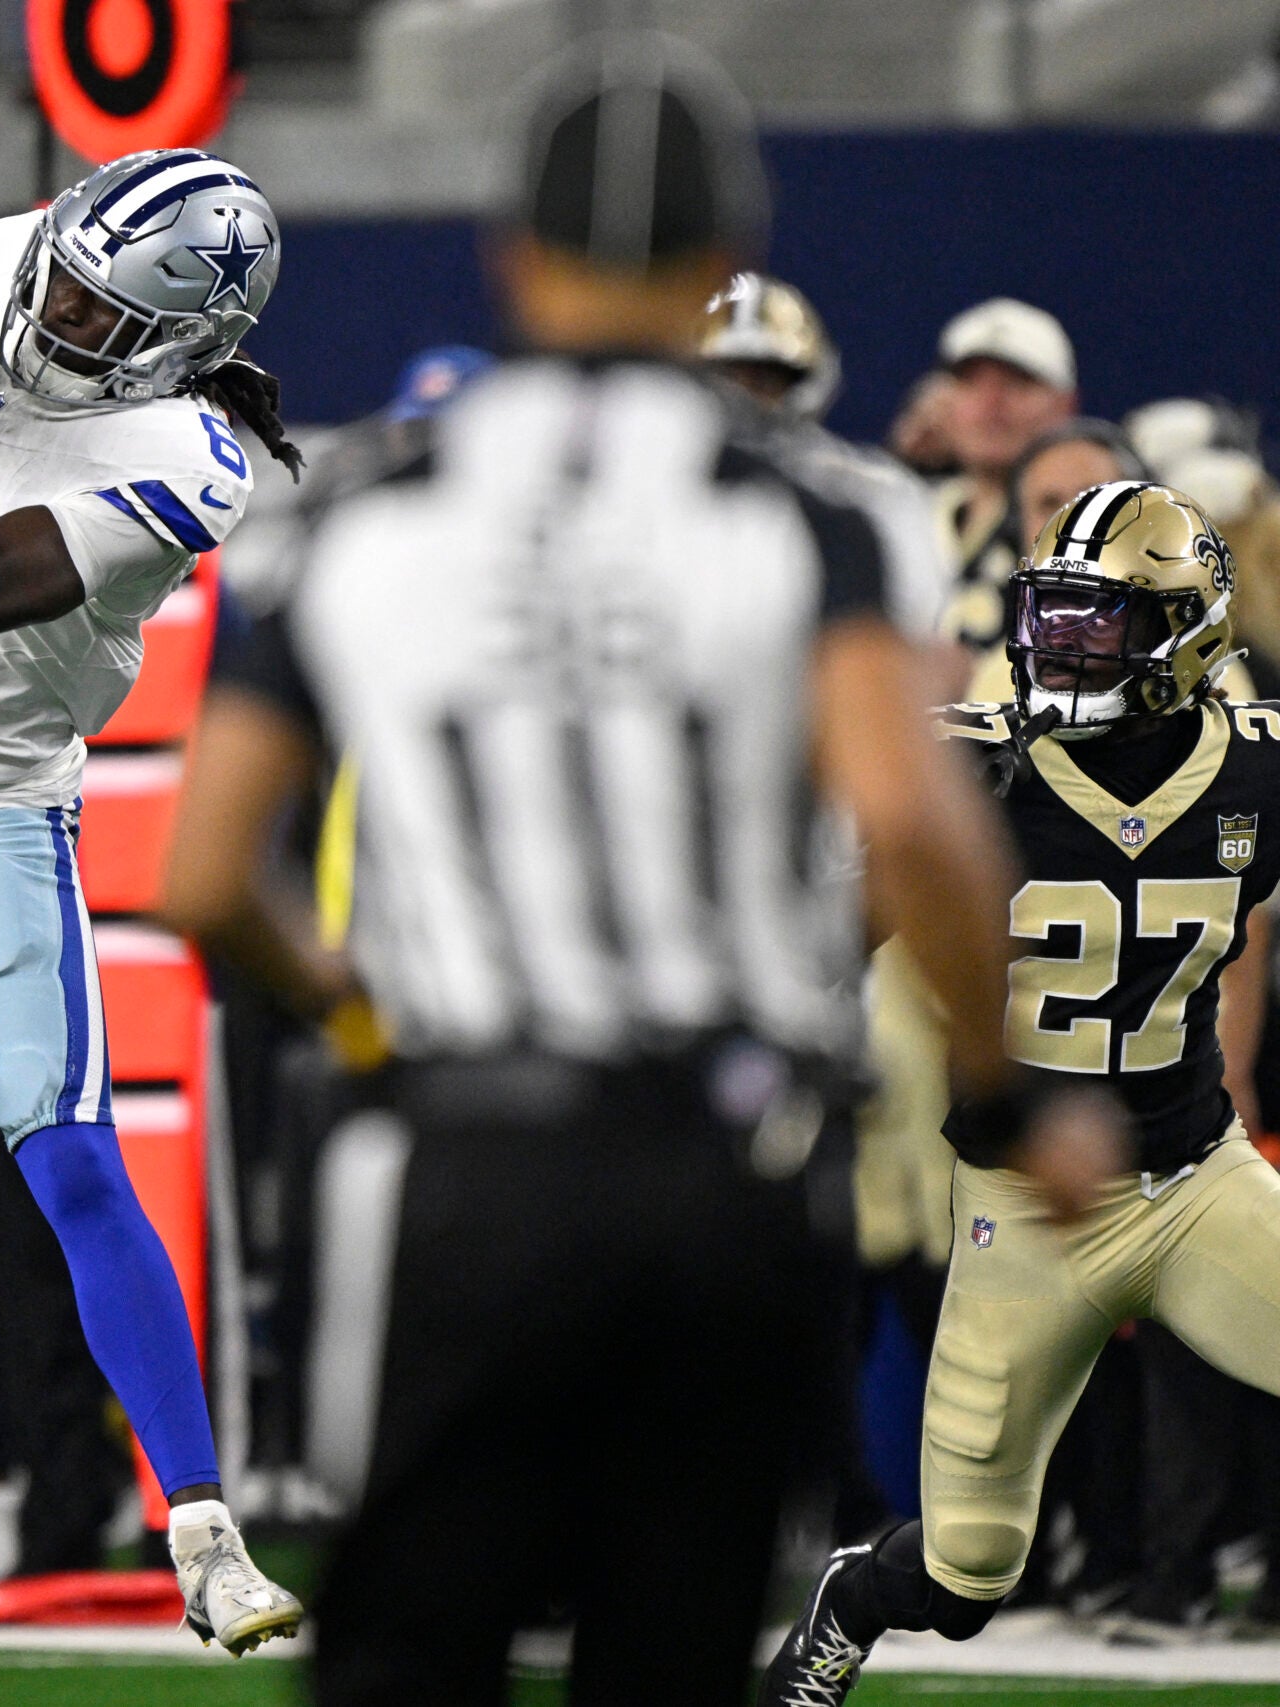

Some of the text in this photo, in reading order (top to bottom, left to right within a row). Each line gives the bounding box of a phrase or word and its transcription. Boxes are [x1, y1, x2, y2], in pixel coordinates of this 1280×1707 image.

[70, 233, 103, 268] COWBOYS
[198, 412, 247, 480] 6
[1049, 558, 1089, 573] SAINTS
[1123, 829, 1143, 843] NFL
[1222, 838, 1251, 859] 60
[1003, 877, 1242, 1075] 27
[974, 1228, 989, 1243] NFL
